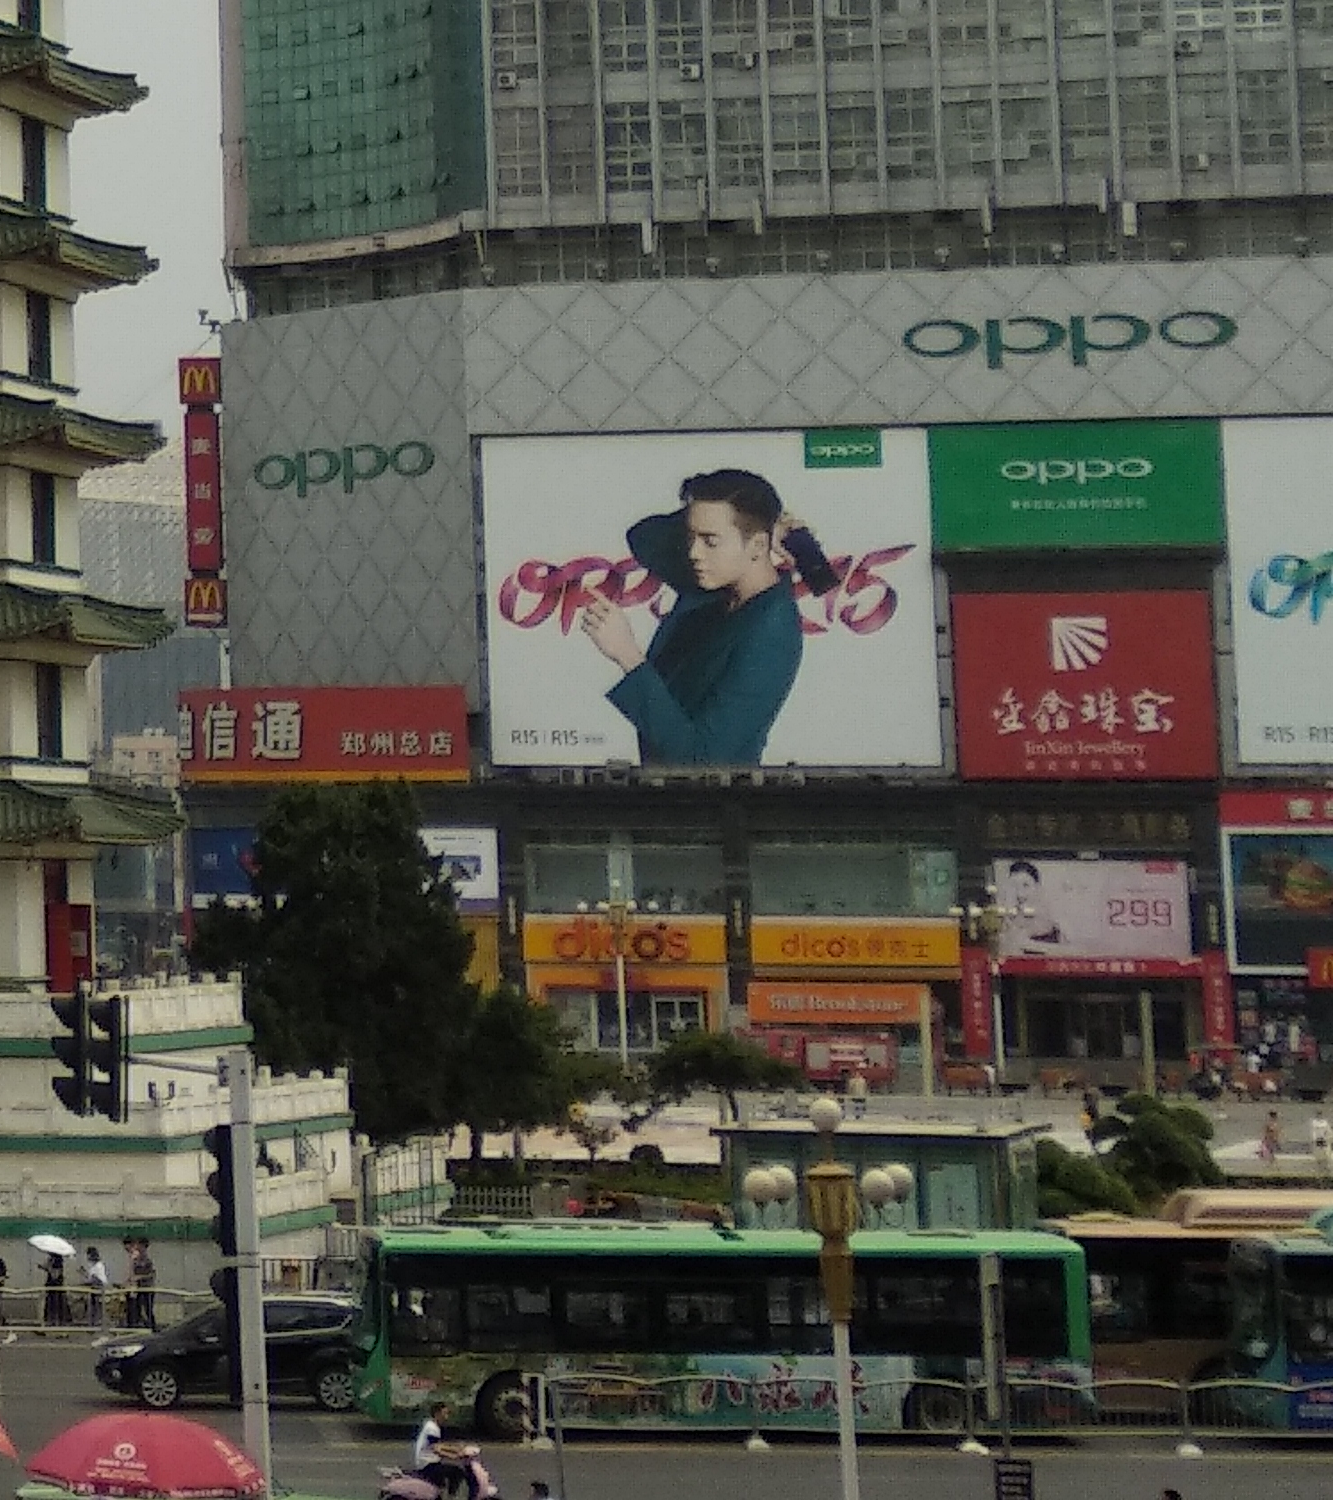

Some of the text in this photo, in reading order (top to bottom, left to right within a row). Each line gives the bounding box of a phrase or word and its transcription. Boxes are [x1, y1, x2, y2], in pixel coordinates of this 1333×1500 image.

[340, 730, 455, 757] 郑州总店
[1107, 900, 1172, 927] 299
